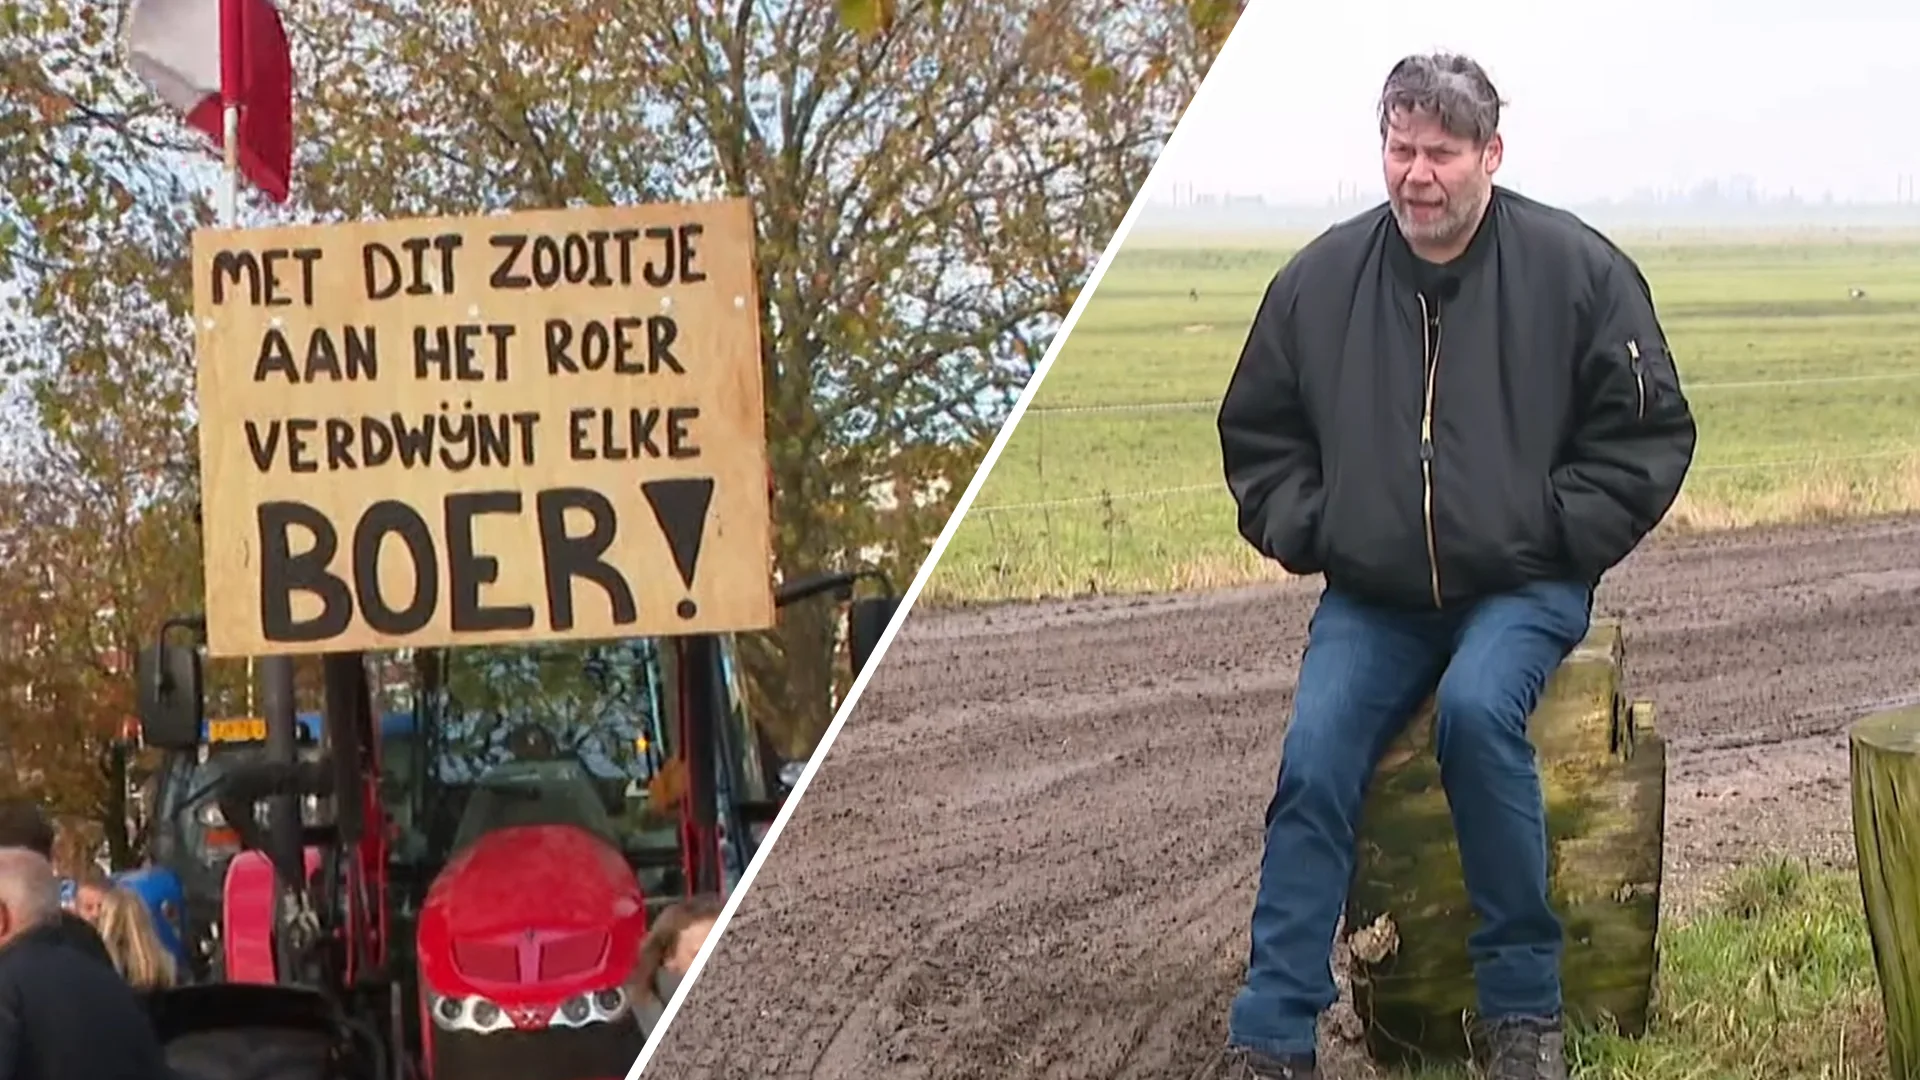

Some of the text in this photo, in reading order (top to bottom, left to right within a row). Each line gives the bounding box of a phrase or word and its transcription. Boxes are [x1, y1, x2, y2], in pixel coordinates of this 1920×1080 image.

[212, 224, 707, 306] MET DIT ZOOITJE
[253, 315, 686, 384] AAN HET ROER
[569, 406, 701, 461] ELKE
[257, 477, 715, 643] BOER!
